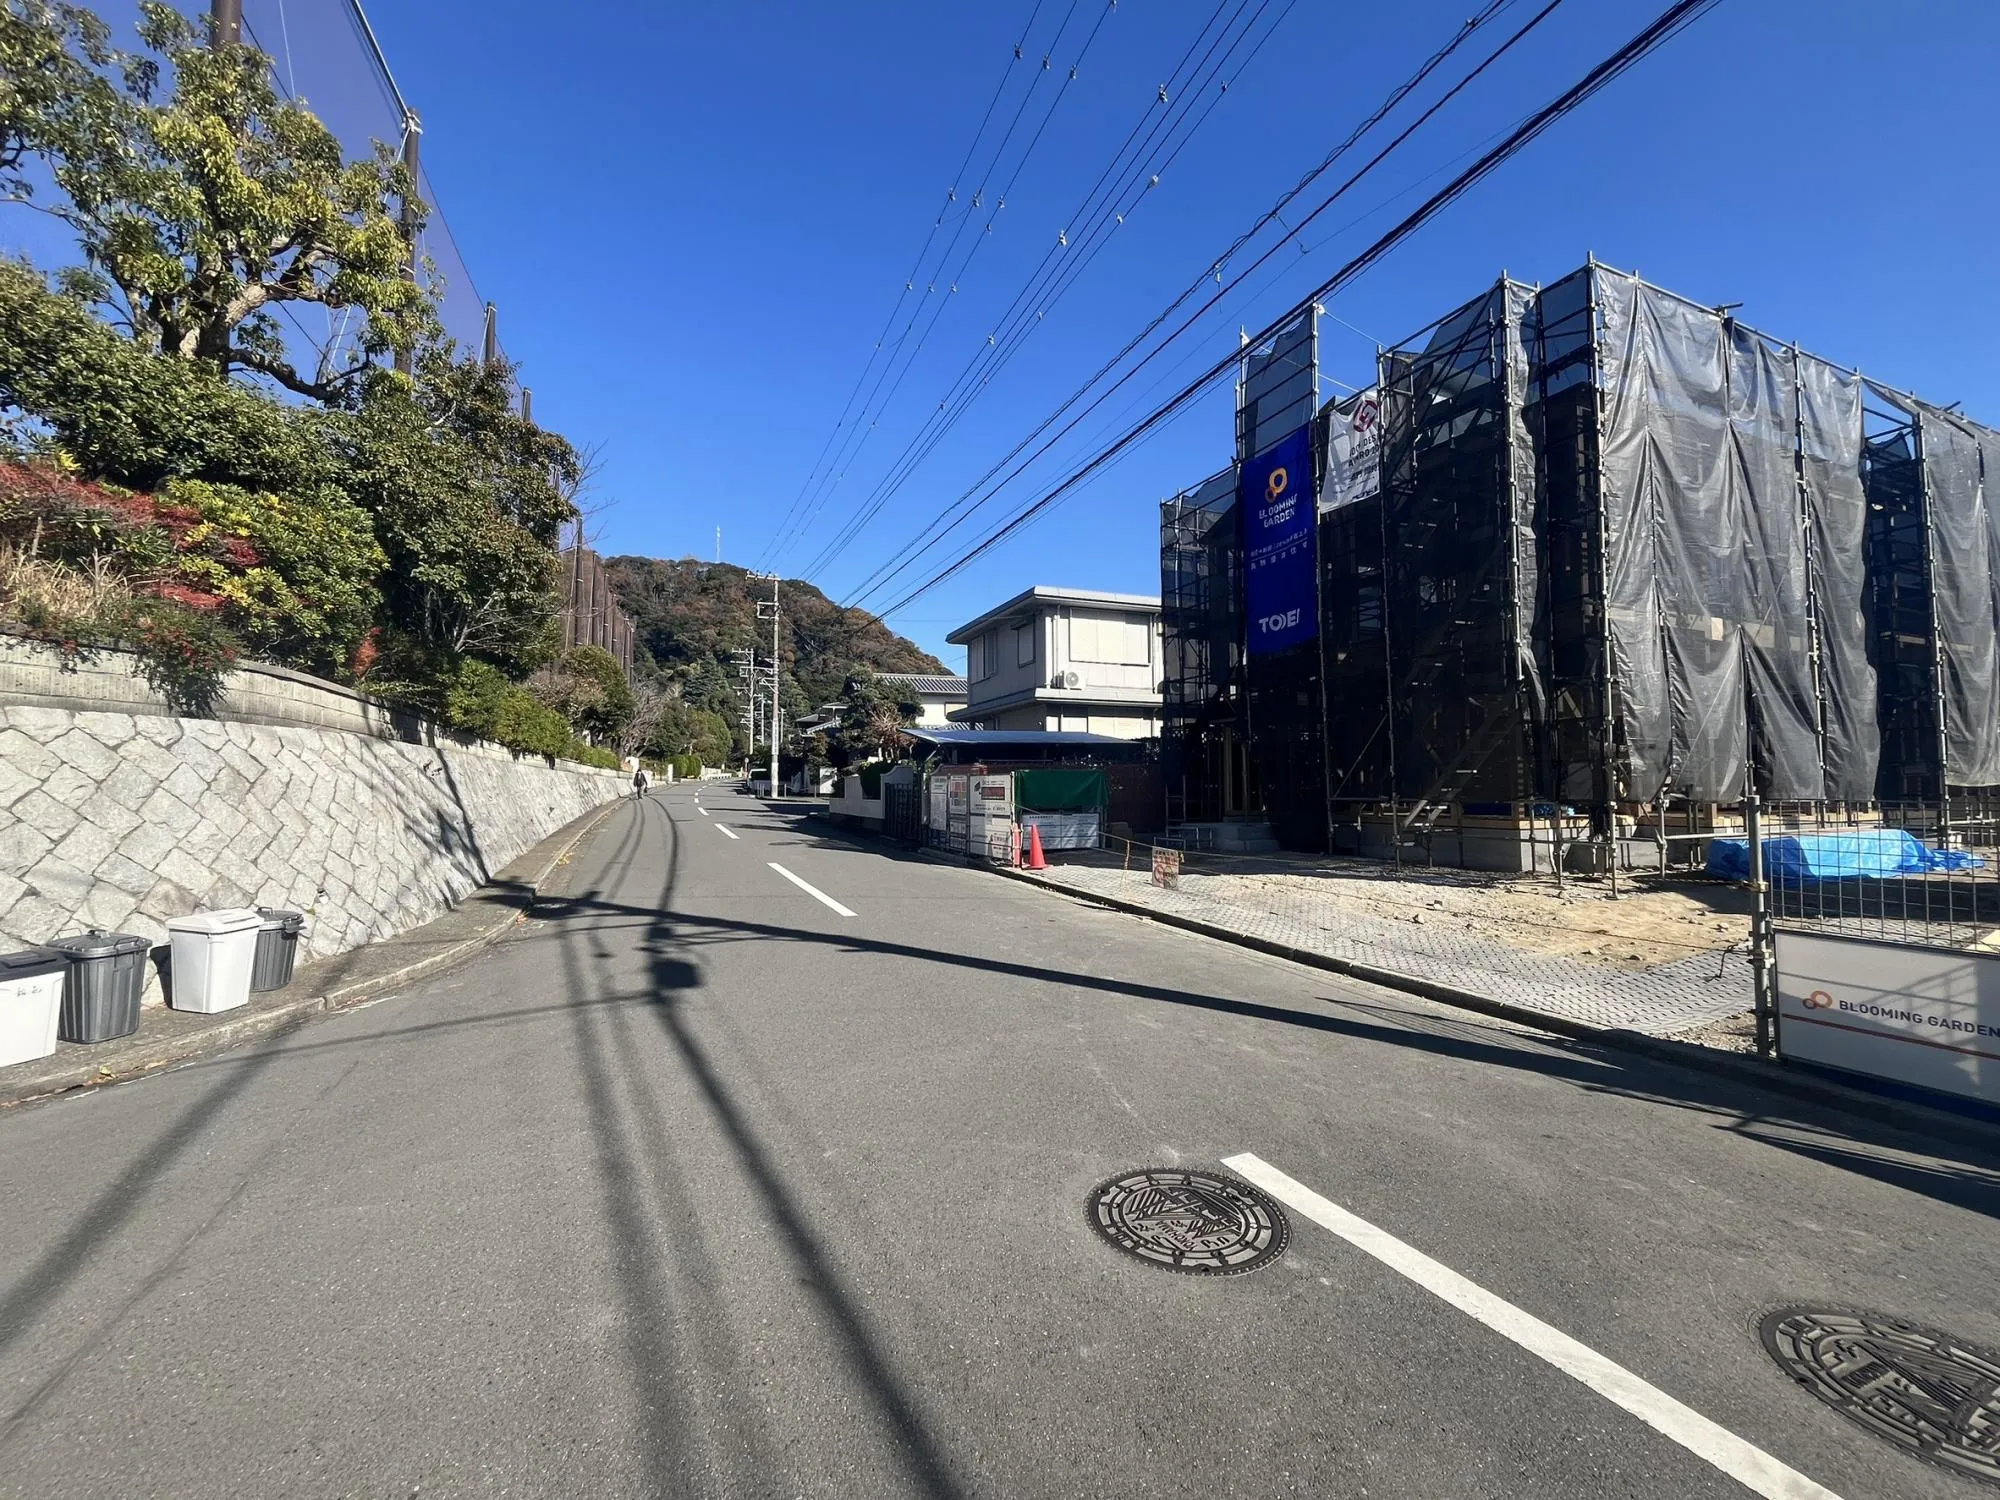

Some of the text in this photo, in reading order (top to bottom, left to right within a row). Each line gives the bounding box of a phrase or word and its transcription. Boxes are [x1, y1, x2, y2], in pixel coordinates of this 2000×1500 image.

[1264, 507, 1295, 528] GARDEN
[1839, 1000, 2000, 1037] BLOOMING GARDEN
